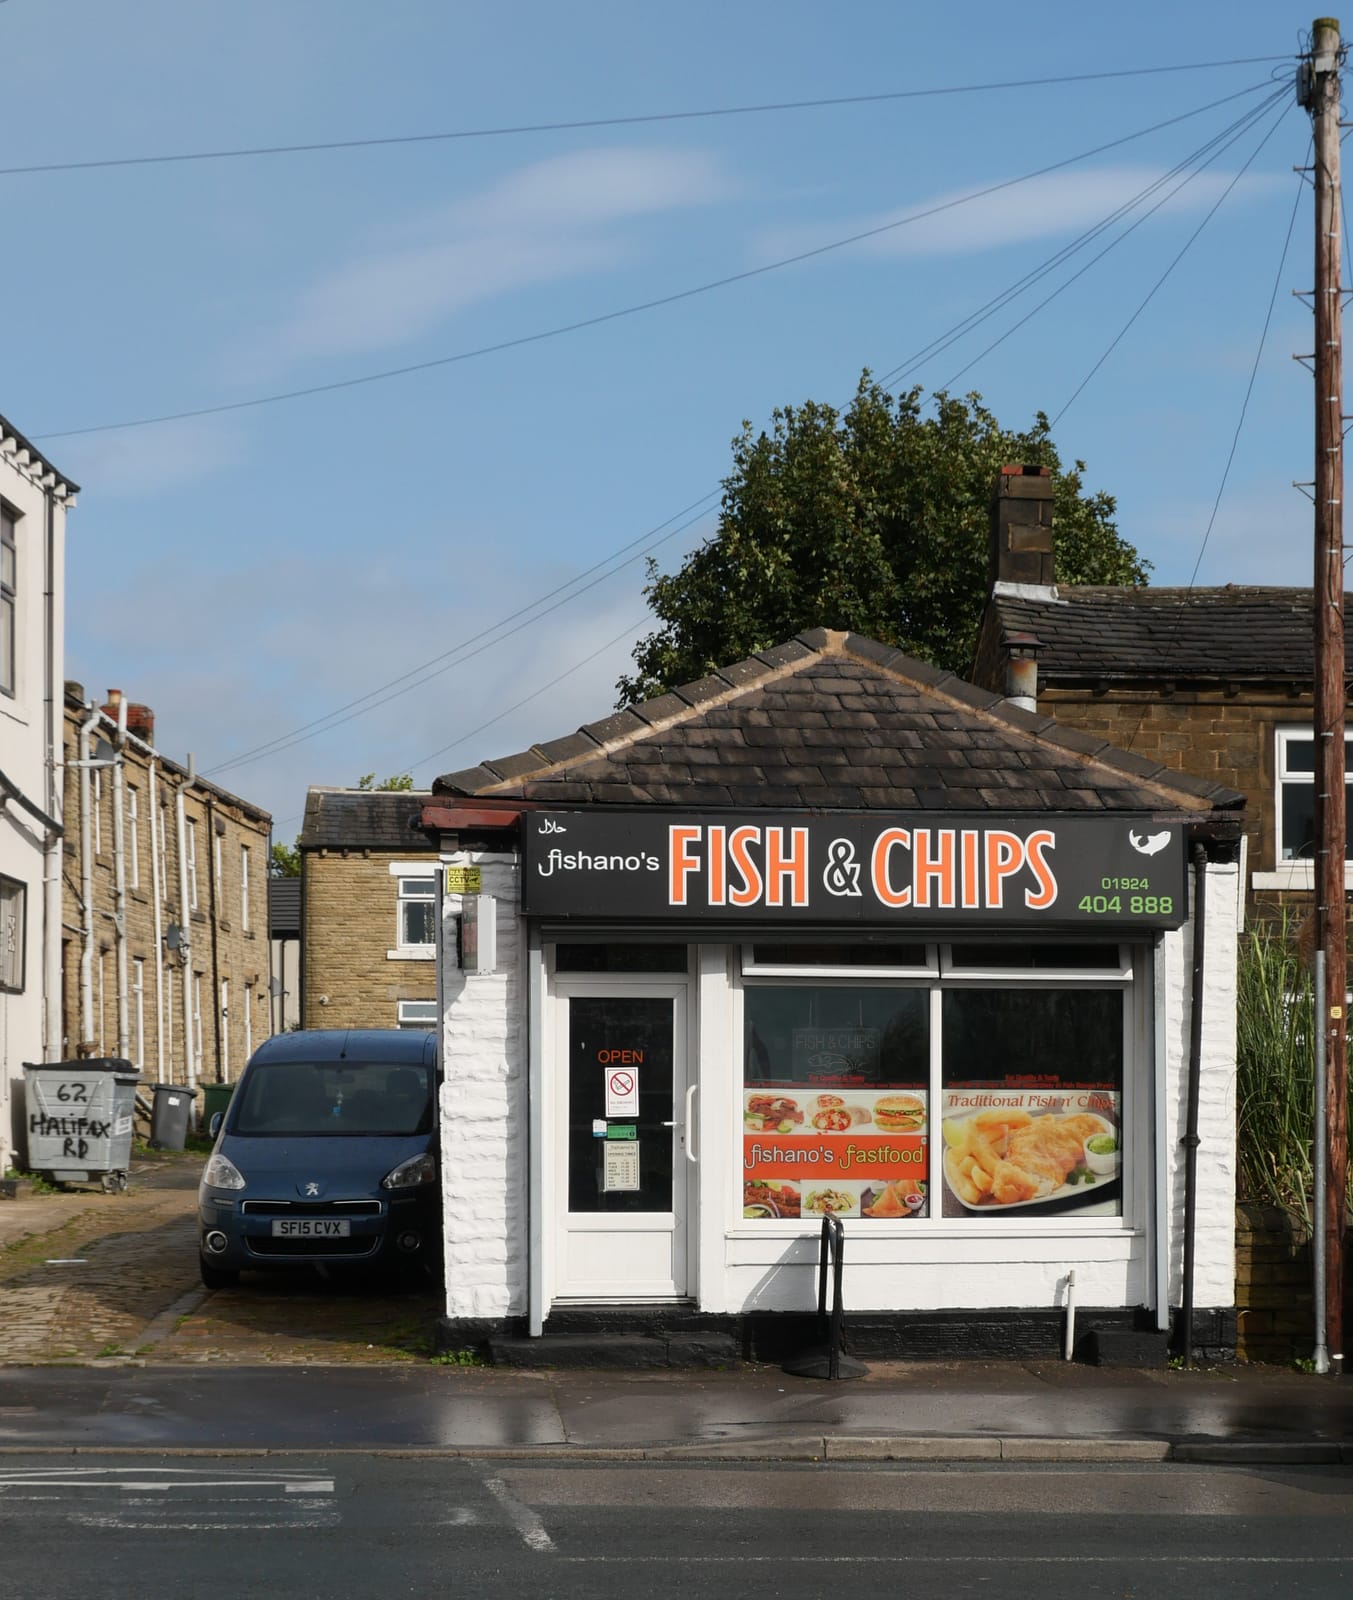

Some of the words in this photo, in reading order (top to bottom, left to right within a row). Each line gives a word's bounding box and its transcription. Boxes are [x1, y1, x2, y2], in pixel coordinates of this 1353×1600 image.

[538, 849, 661, 876] fishano's
[669, 825, 810, 906] FISH
[823, 838, 862, 896] &
[871, 827, 1058, 910] CHIPS
[1101, 877, 1150, 891] 01924
[1078, 895, 1122, 914] 404
[1130, 896, 1174, 915] 888
[597, 1050, 644, 1064] OPEN
[57, 1083, 87, 1102] 62
[948, 1095, 1024, 1108] Traditional
[1027, 1095, 1057, 1108] Fish
[63, 1137, 89, 1159] RD
[744, 1144, 834, 1169] fishano's
[839, 1144, 923, 1169] fastfood
[280, 1221, 311, 1235] SF15
[314, 1221, 341, 1235] CVX
